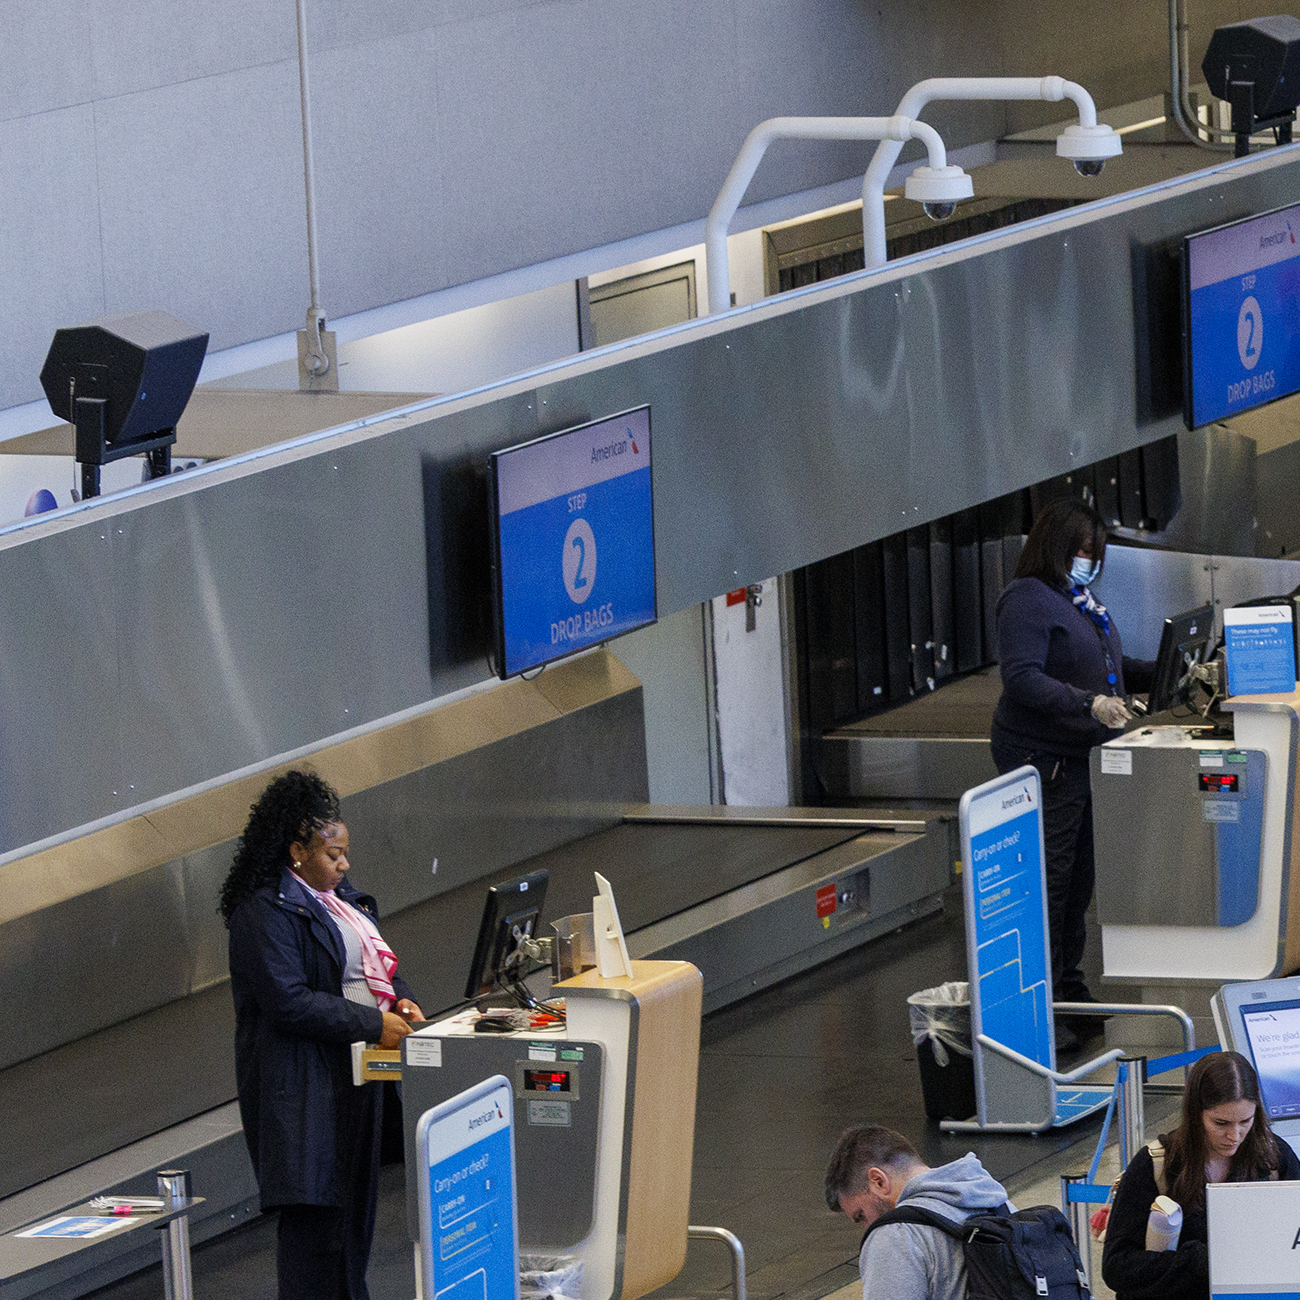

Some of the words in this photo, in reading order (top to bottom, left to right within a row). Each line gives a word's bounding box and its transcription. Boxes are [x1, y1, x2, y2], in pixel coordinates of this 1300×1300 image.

[1241, 275, 1256, 292] STEP
[1244, 311, 1256, 357] 2
[1227, 379, 1251, 403] DROP
[1253, 370, 1276, 394] BAGS
[591, 440, 627, 464] American
[567, 493, 587, 513] STEP
[572, 536, 588, 590] 2
[551, 612, 583, 644] DROP
[584, 602, 614, 632] BAGS
[1002, 793, 1025, 809] American
[1256, 1033, 1281, 1043] We're
[1282, 1030, 1300, 1043] glad
[468, 1109, 495, 1131] American
[434, 1169, 461, 1193] Carry-on
[470, 1153, 489, 1175] check?
